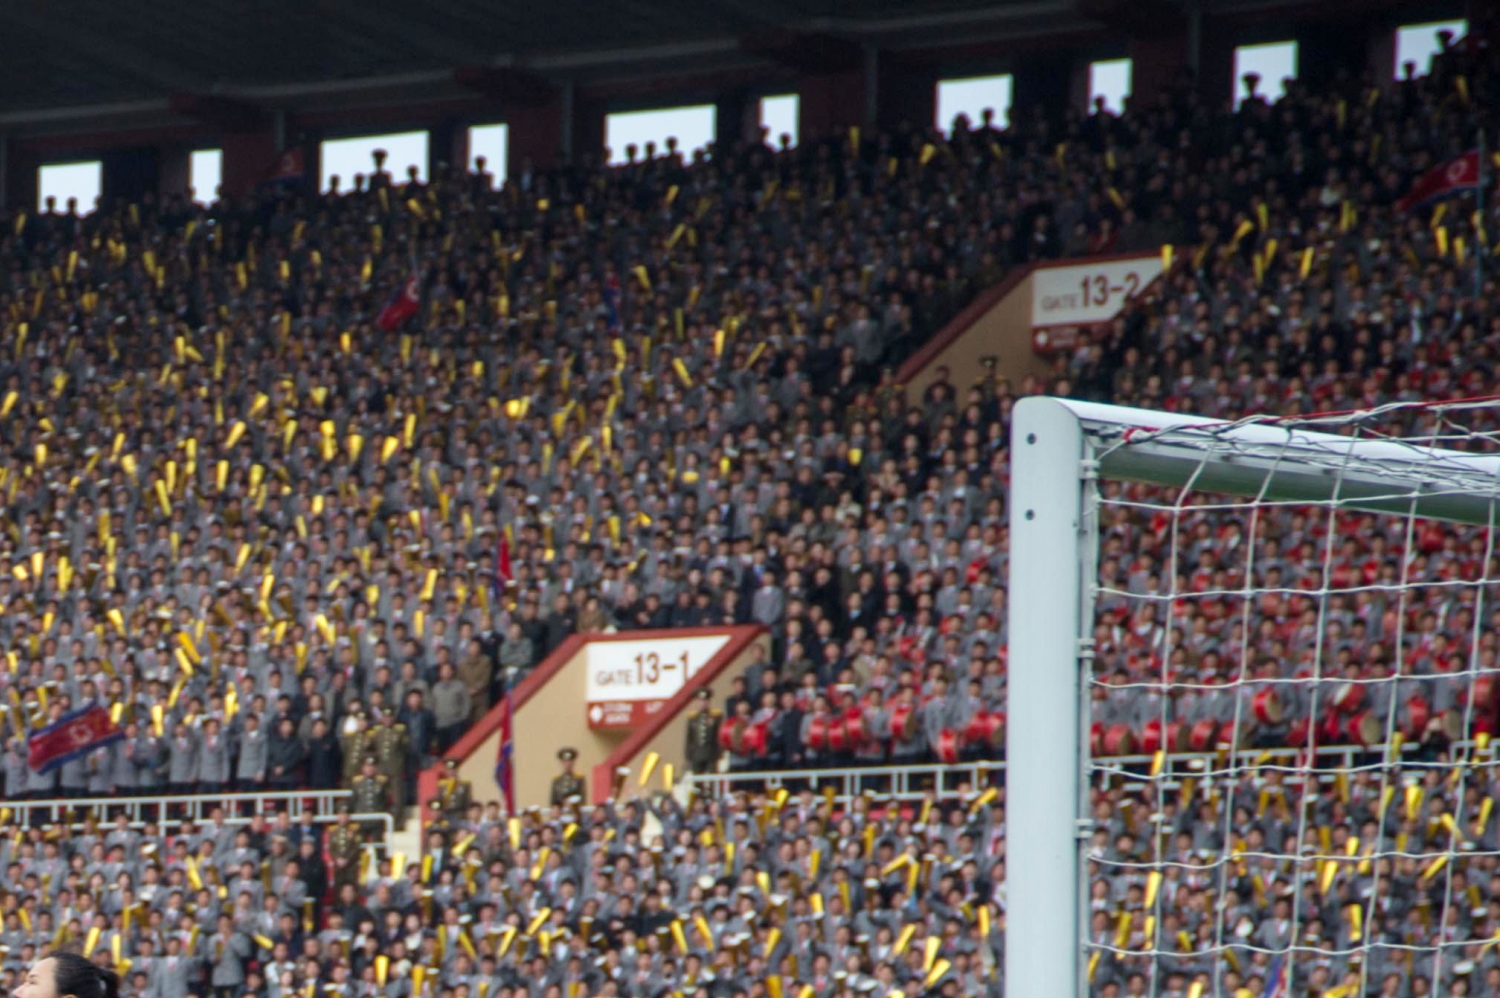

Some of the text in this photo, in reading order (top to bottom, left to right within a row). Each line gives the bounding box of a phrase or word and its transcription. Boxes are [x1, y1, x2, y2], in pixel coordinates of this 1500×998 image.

[1081, 272, 1140, 307] 13-2
[596, 650, 690, 686] GATE 13-1
